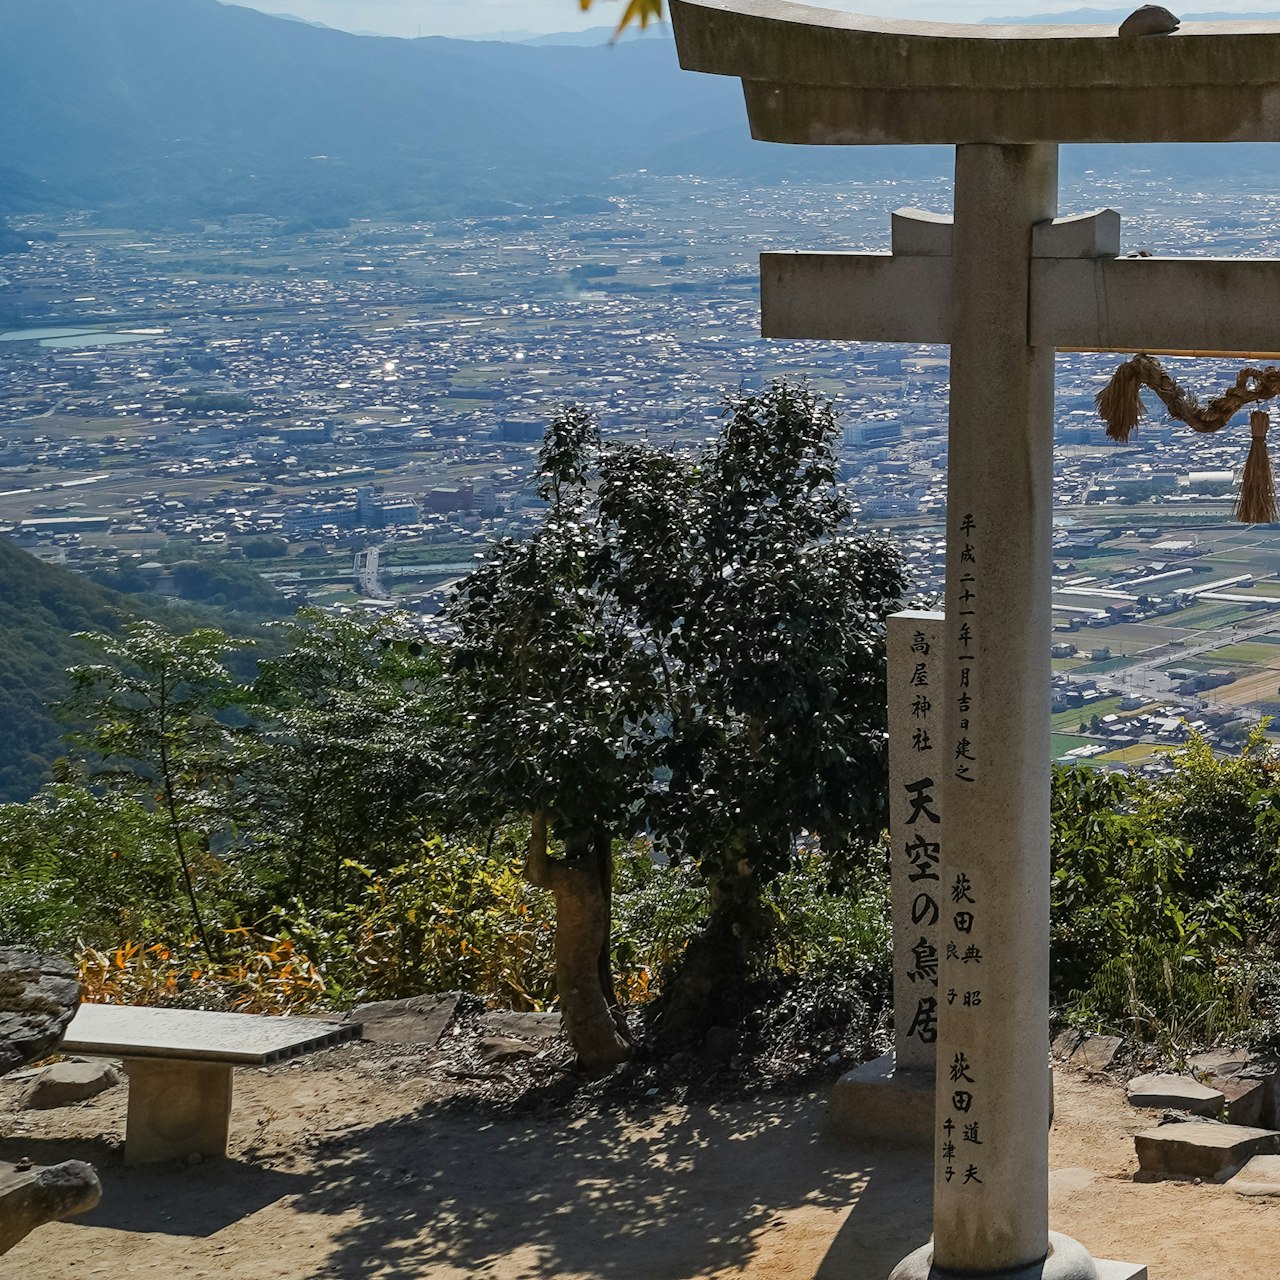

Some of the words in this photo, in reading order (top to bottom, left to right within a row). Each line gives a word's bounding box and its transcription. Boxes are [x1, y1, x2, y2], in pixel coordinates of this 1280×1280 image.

[909, 631, 932, 753] 高屋神社
[954, 514, 977, 783] 平成二十一年一月吉日建之
[904, 777, 941, 1044] 天空の鳥居
